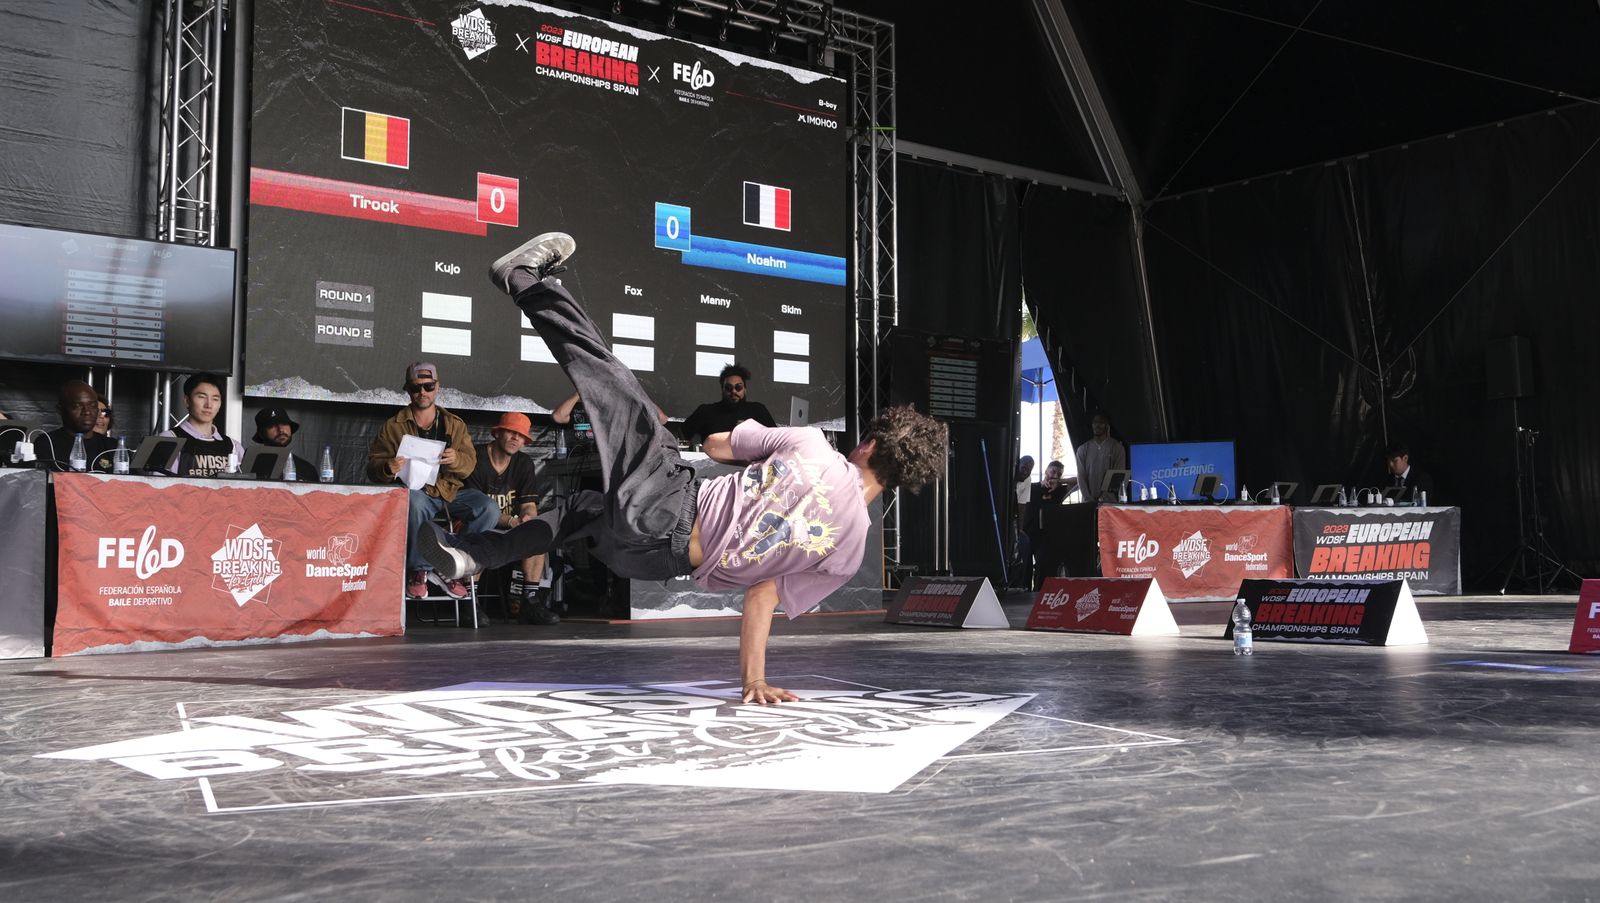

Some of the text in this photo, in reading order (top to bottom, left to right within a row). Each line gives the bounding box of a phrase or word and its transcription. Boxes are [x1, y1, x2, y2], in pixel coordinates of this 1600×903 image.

[460, 13, 491, 35] WDSF
[541, 24, 563, 36] 2023
[453, 26, 496, 44] BREAKING
[536, 29, 639, 62] WDSF EUROPEAN
[536, 41, 639, 86] BREAKING
[536, 66, 639, 96] CHAMPIONSHIPS SPAIN
[490, 188, 505, 213] 0
[666, 216, 679, 239] 0
[435, 262, 460, 275] Kujo
[320, 289, 371, 303] ROUND 1
[625, 285, 643, 296] Fox
[700, 294, 731, 308] Manny
[317, 325, 372, 338] ROUND 2
[1151, 464, 1215, 480] SCOOTERING
[1316, 521, 1434, 545] WDSF EUROPEAN
[1323, 524, 1349, 534] 2023
[226, 538, 273, 560] WDSF
[1180, 539, 1207, 552] WDSF
[306, 546, 326, 560] world
[1173, 551, 1211, 560] BREAKING
[1224, 552, 1268, 563] DanceSport
[1309, 542, 1431, 573] BREAKING
[213, 560, 281, 574] BREAKING
[306, 563, 369, 578] DanceSport
[1397, 571, 1429, 580] SPAIN
[99, 584, 182, 595] FEDERACIÓN ESPAÑOLA
[342, 579, 367, 592] federation
[109, 597, 172, 606] BAILE DEPORTIVO
[1286, 588, 1371, 603] EUROPEAN
[1255, 603, 1366, 625] BREAKING
[1252, 624, 1360, 634] CHAMPIONSHIPS SPAIN
